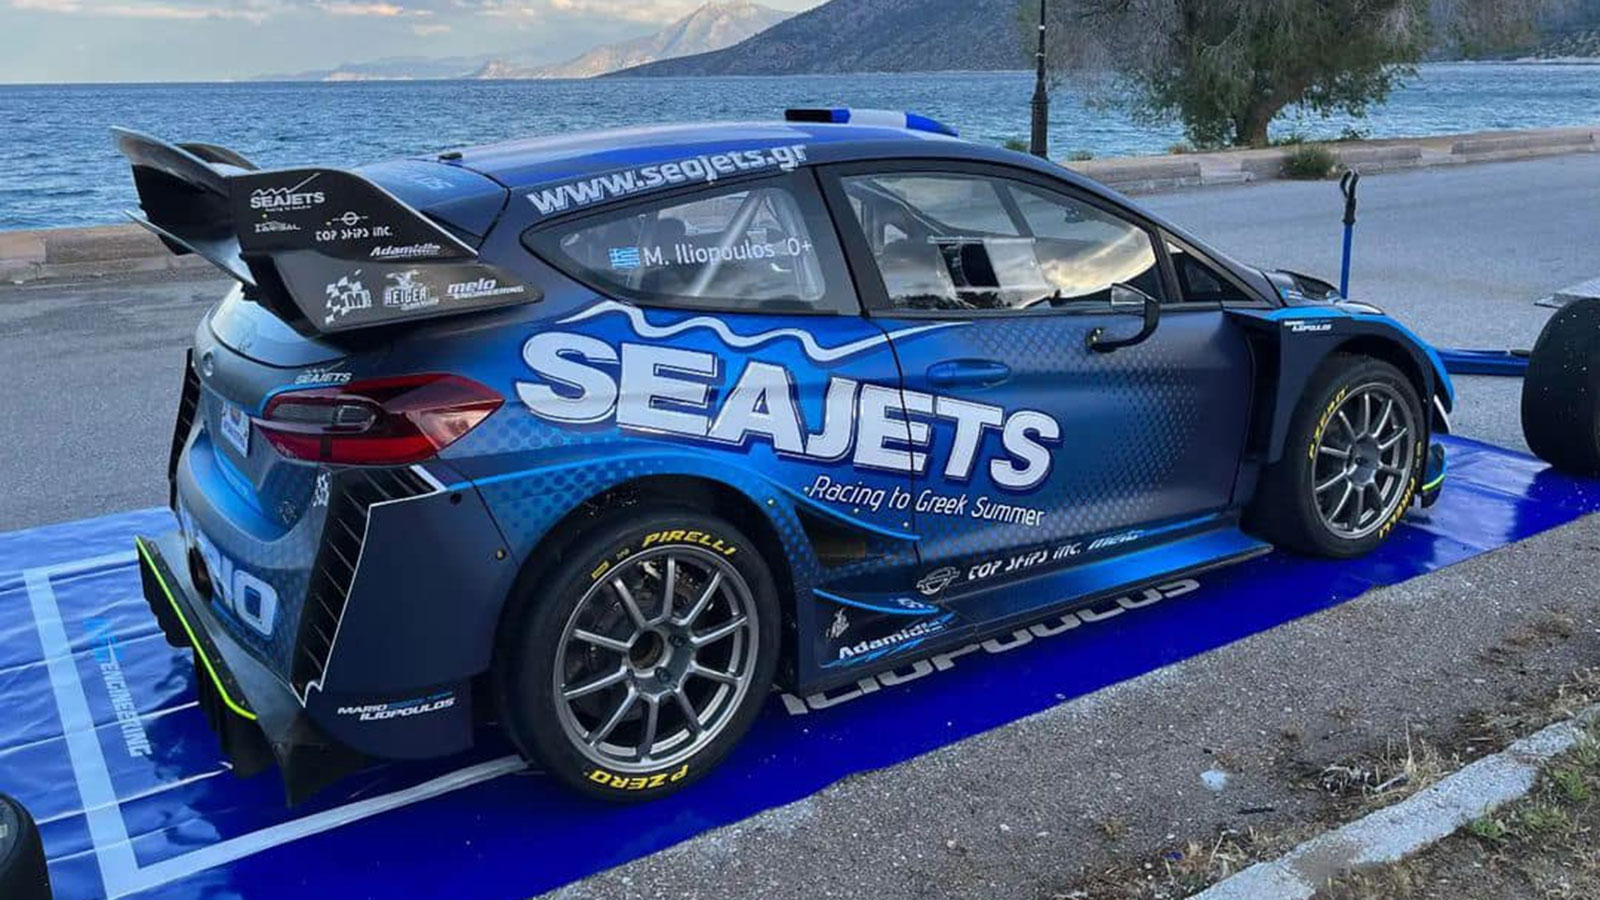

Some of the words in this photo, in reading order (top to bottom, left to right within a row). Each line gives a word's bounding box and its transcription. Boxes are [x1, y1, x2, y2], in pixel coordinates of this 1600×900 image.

[526, 144, 807, 215] www.seajets.gr
[250, 192, 325, 209] SEAJETS
[643, 246, 669, 267] M.
[675, 239, 775, 266] Iliopoulos
[448, 278, 497, 295] melo
[514, 331, 1064, 490] SEAJETS
[808, 475, 885, 512] Racing
[888, 491, 909, 509] to
[915, 489, 967, 515] Greek
[971, 496, 1045, 527] Summer
[642, 529, 737, 556] PIRELLI
[100, 659, 153, 759] ENGINEERING
[337, 703, 388, 715] MARIO
[360, 697, 456, 721] ILIOPOULOS
